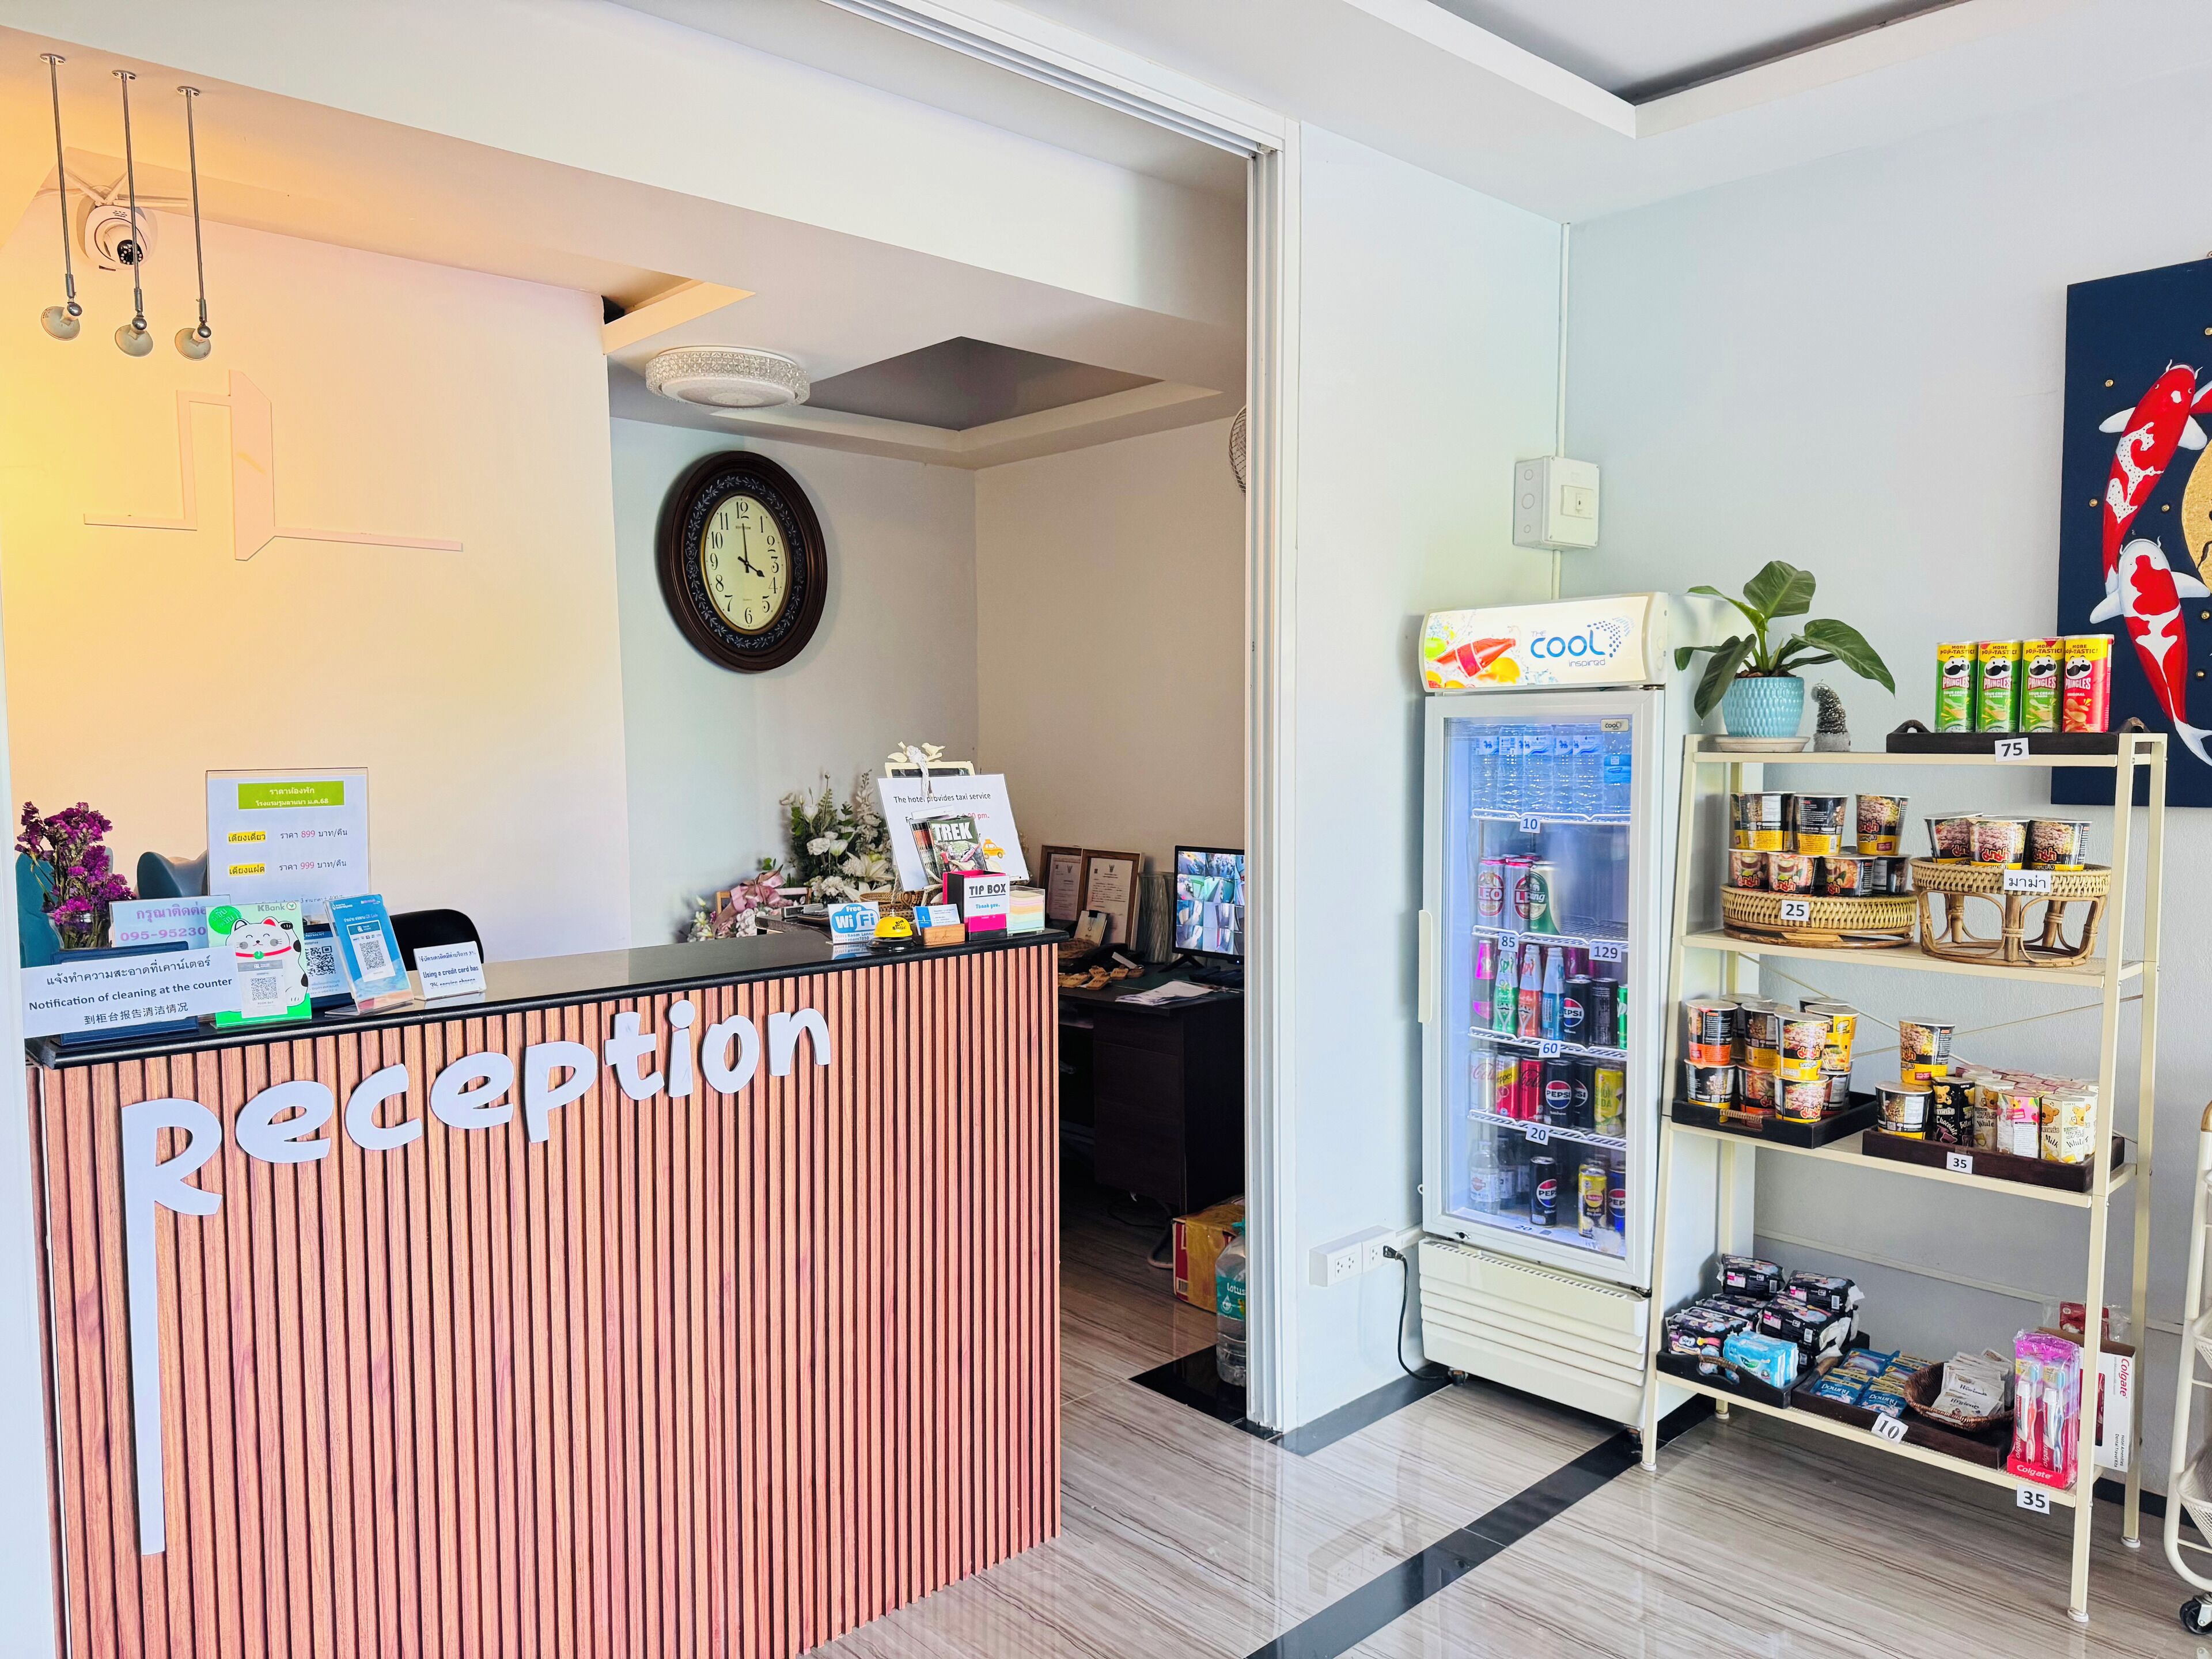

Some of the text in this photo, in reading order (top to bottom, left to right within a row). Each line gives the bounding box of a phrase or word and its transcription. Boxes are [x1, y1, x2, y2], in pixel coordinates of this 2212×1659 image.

[736, 501, 749, 519] 12
[720, 512, 728, 530] 11
[760, 516, 764, 533] 1
[711, 531, 723, 549] 10
[767, 535, 775, 552] 2
[710, 553, 718, 570] 9
[771, 556, 779, 573] 3
[715, 575, 724, 592] 8
[768, 577, 778, 594] 4
[724, 594, 733, 612] 7
[762, 595, 770, 613] 5
[744, 607, 752, 624] 6
[1569, 658, 1605, 667] inspired
[1942, 676, 1969, 688] PRINGLES
[1984, 677, 2011, 690] PRINGLES
[2028, 676, 2056, 689] PRINGLES
[2065, 678, 2091, 690] PRINGLES
[2001, 743, 2023, 757] 75
[1524, 819, 1537, 830] 10
[301, 830, 316, 838] 899
[931, 822, 972, 842] TREK
[2009, 875, 2046, 889] มาม่า
[969, 884, 1006, 895] TIP BOX
[1478, 888, 1502, 900] LEO
[1516, 891, 1531, 903] LE
[1786, 904, 1805, 915] 25
[120, 927, 206, 941] 095-95230
[1502, 936, 1515, 947] 85
[1594, 946, 1618, 959] 129
[29, 995, 95, 1010] Notification
[98, 993, 109, 1003] of
[112, 987, 157, 1001] cleaning
[172, 983, 190, 993] the
[193, 978, 233, 991] counter
[84, 1002, 188, 1025] 到柜台报告清洁情况
[1543, 1043, 1558, 1054] 60
[1936, 1116, 1958, 1135] Chocolate
[1531, 1128, 1546, 1141] 20
[2046, 1134, 2058, 1148] Milk
[1953, 1158, 1967, 1169] 35
[122, 999, 830, 1555] Reception
[2119, 1358, 2130, 1397] Colgate
[1821, 1384, 1850, 1395] Downy
[1869, 1394, 1897, 1406] Downy
[1878, 1420, 1899, 1439] 10
[2017, 1465, 2051, 1479] Colgate
[2023, 1491, 2046, 1508] 35
